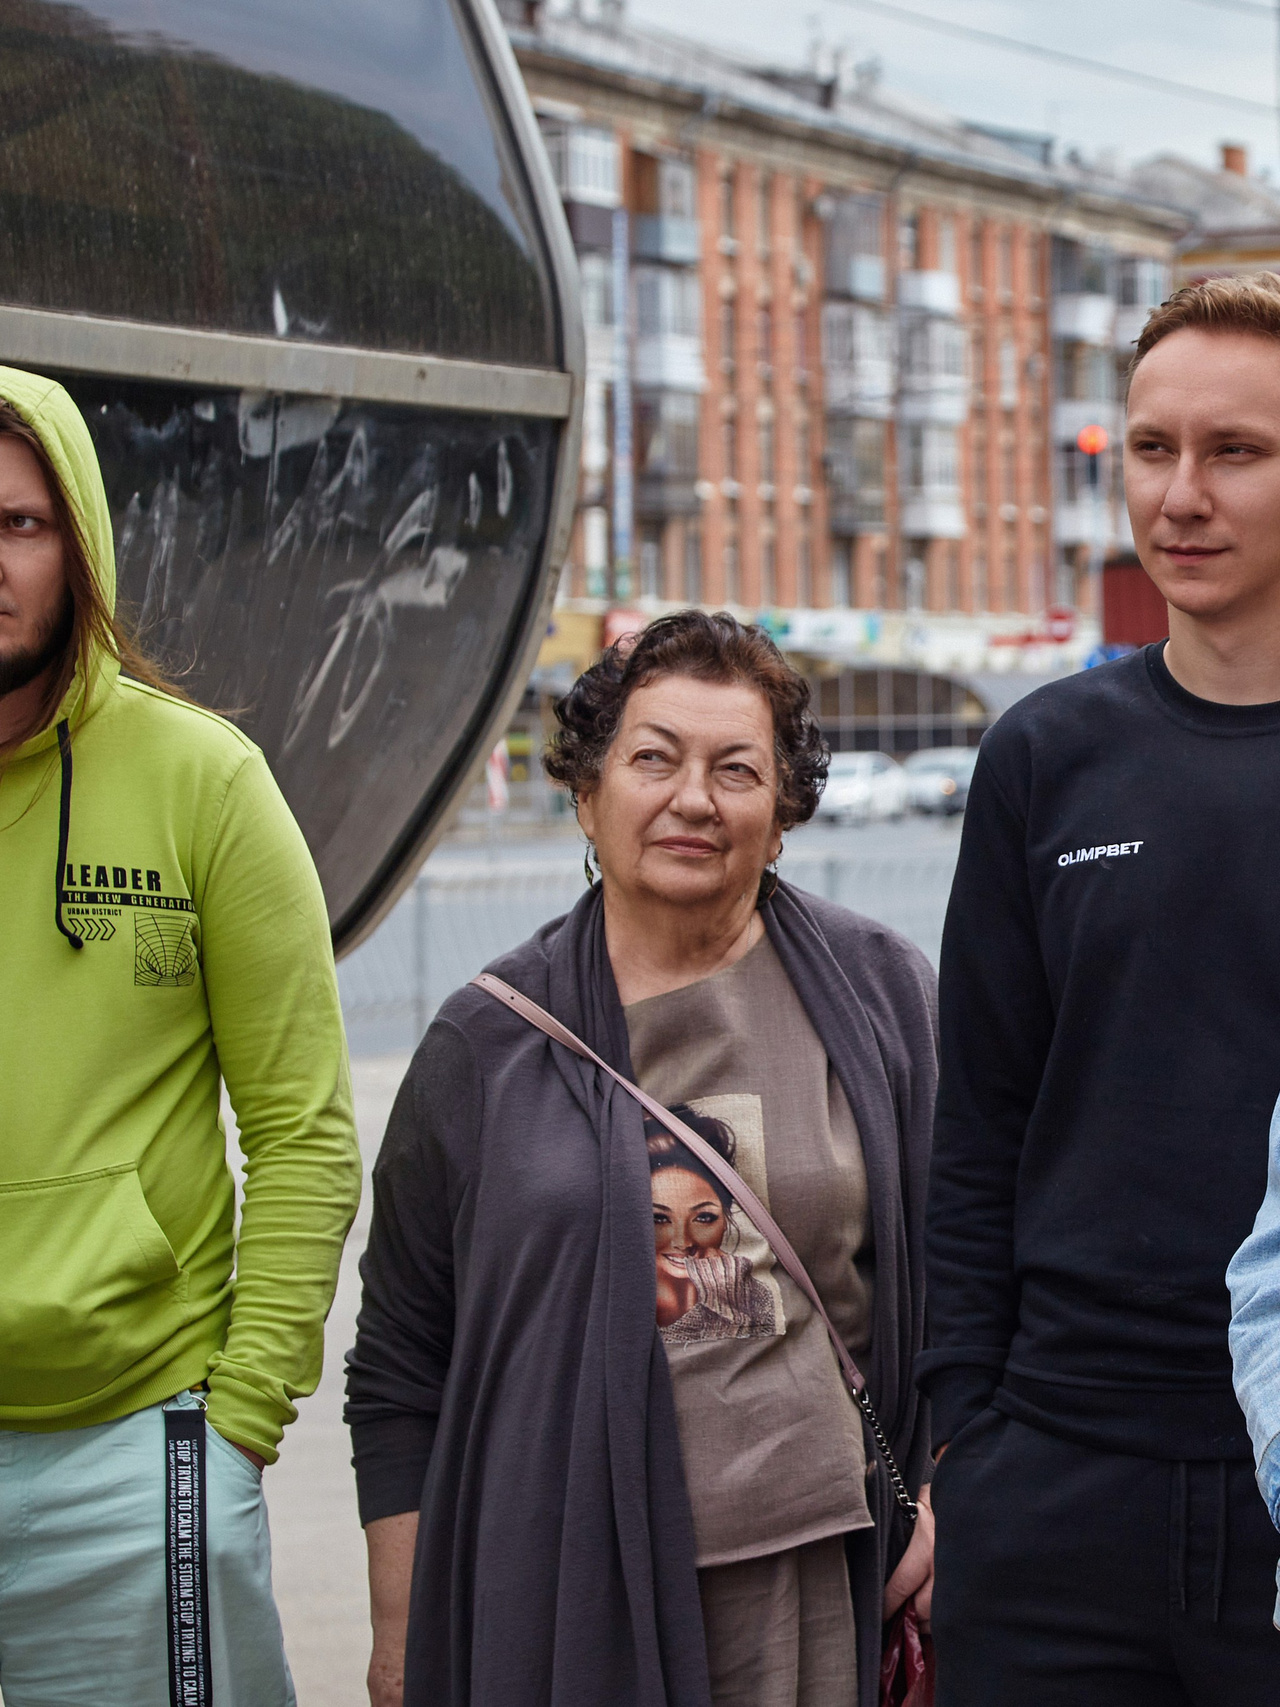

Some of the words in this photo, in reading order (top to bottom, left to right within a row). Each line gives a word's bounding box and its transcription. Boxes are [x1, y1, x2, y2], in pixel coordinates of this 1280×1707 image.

[1057, 841, 1144, 867] OLIMPBET
[66, 864, 161, 892] LEADER
[67, 892, 88, 903] THE
[97, 893, 121, 904] NEW
[67, 907, 90, 916] URBAN
[92, 907, 122, 917] DISTRICT
[176, 1440, 191, 1462] STOP
[177, 1465, 192, 1496] TRYING
[178, 1498, 192, 1510] TO
[178, 1513, 192, 1539] CALM
[178, 1541, 192, 1560] THE
[179, 1563, 193, 1597] STORM
[179, 1600, 195, 1624] STOP
[181, 1627, 196, 1663] TRYING
[182, 1665, 197, 1677] TO
[183, 1680, 198, 1706] CALM
